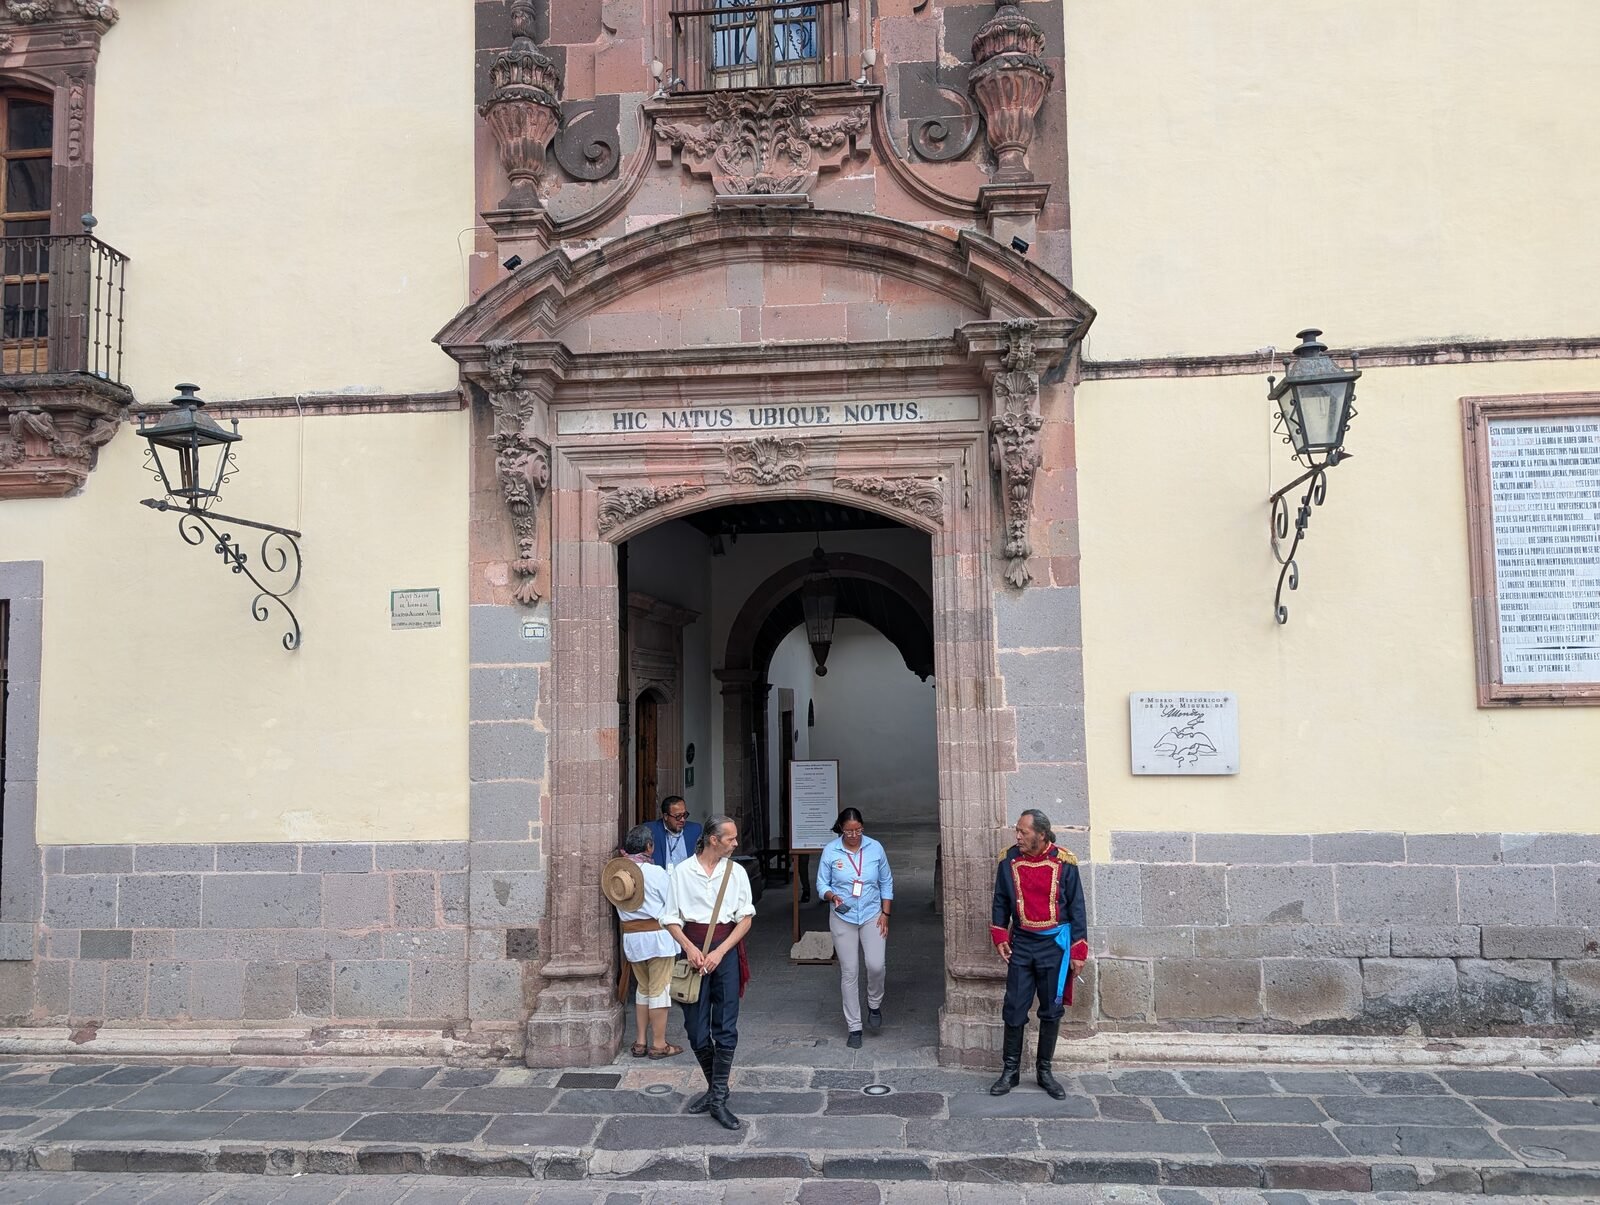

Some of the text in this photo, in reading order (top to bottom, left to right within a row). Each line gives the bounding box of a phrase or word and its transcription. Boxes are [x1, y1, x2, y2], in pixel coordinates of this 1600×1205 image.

[613, 403, 924, 430] HIC NATUS UBIQUE NOTUS.
